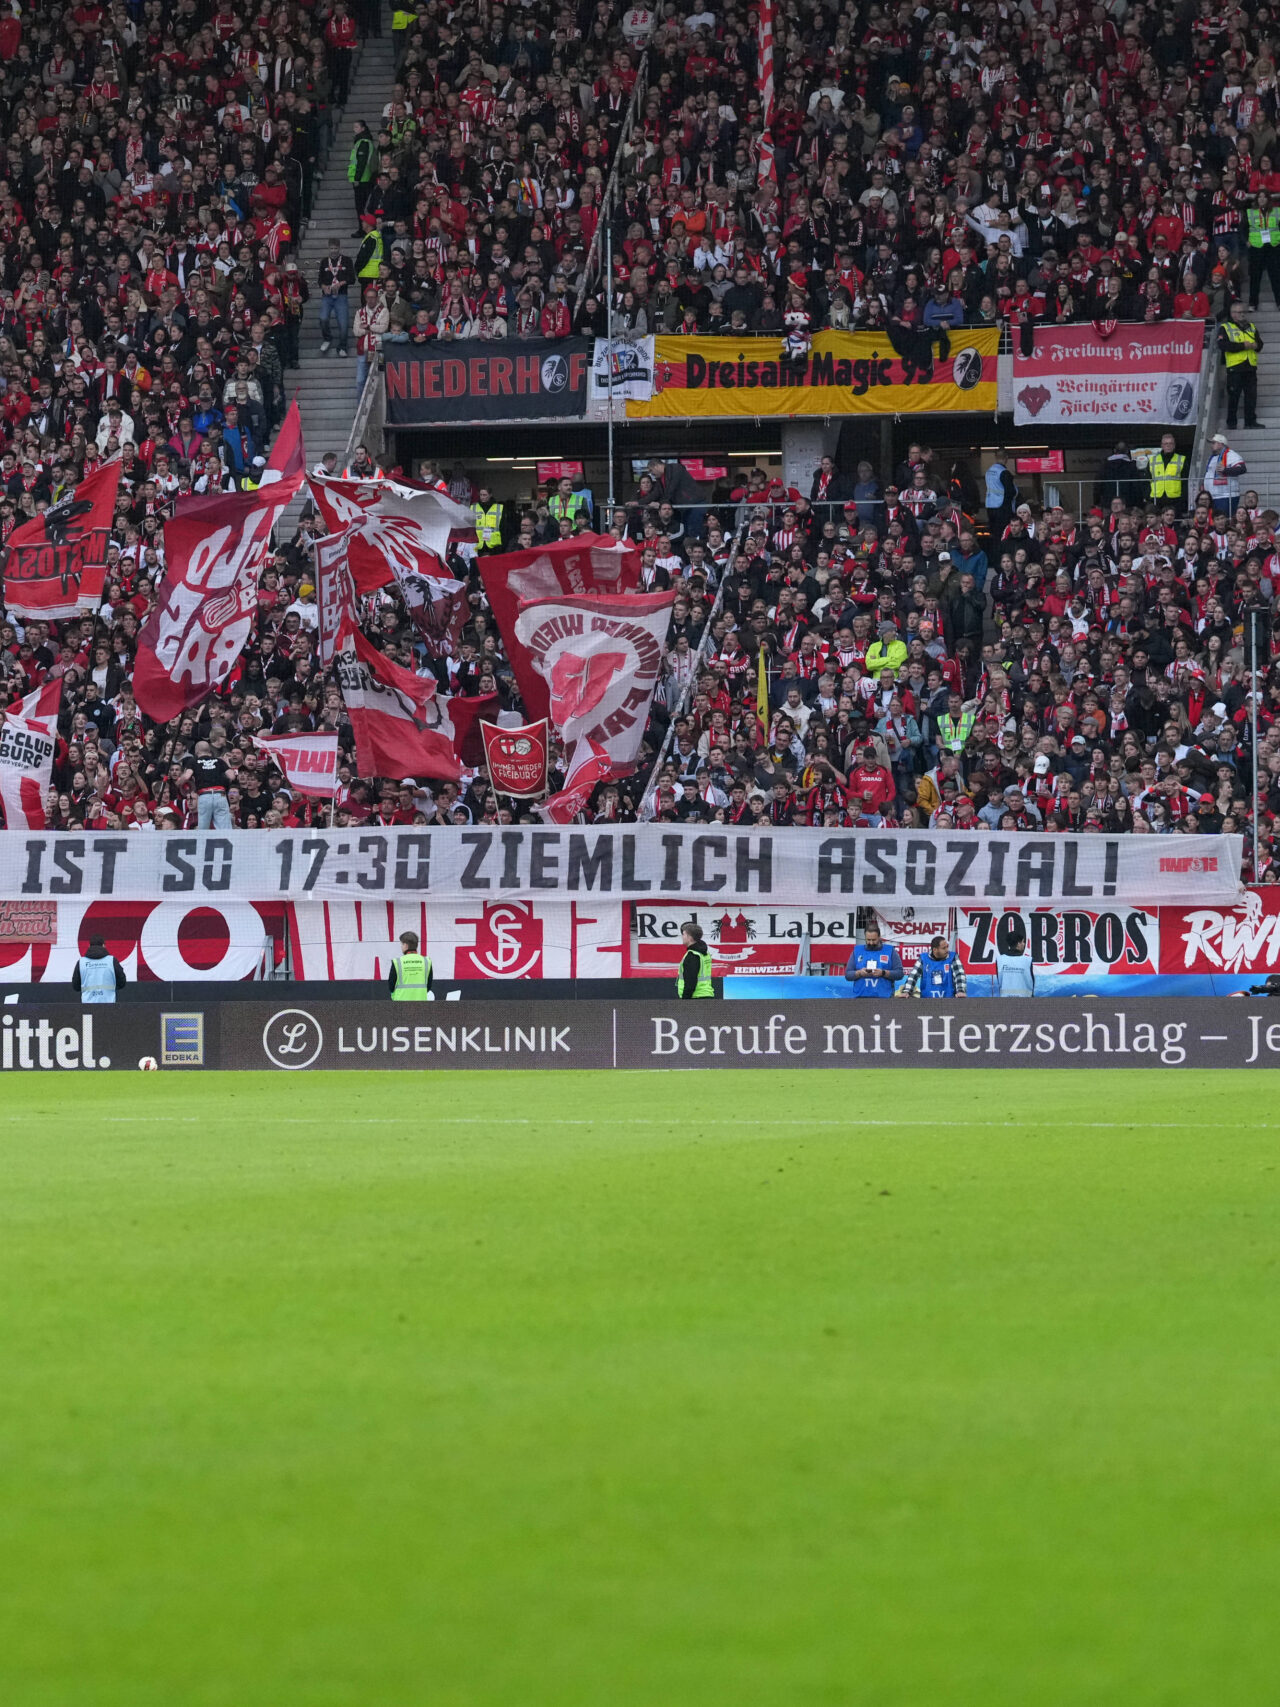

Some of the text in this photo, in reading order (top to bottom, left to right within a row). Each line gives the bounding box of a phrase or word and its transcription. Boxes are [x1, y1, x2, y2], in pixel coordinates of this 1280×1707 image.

[1050, 342, 1123, 362] Freiburg
[1128, 340, 1193, 361] Fanclub
[811, 350, 892, 396] Magic
[1056, 379, 1157, 396] Weingärtner
[1060, 399, 1157, 416] Füchse e.V.
[2, 729, 53, 757] T-CLUB
[0, 744, 43, 768] BURG
[492, 762, 542, 771] IMMER WIEDER
[498, 769, 538, 780] FREIBURG
[22, 838, 127, 896] IST
[163, 837, 233, 891] SO
[275, 834, 432, 892] 17:30
[460, 832, 773, 893] ZIEMLICH
[818, 837, 1119, 898] ASOZIAL!
[768, 911, 856, 938] Label
[968, 911, 1148, 964] ZORROS
[734, 965, 795, 973] HERWELZE
[865, 978, 879, 987] TV
[931, 990, 945, 998] TV
[338, 1026, 571, 1053] LUISENKLINIK
[651, 1014, 807, 1055] Berufe
[823, 1015, 902, 1055] mit
[918, 1012, 1187, 1065] Herzschlag
[164, 1053, 200, 1061] EDEKA
